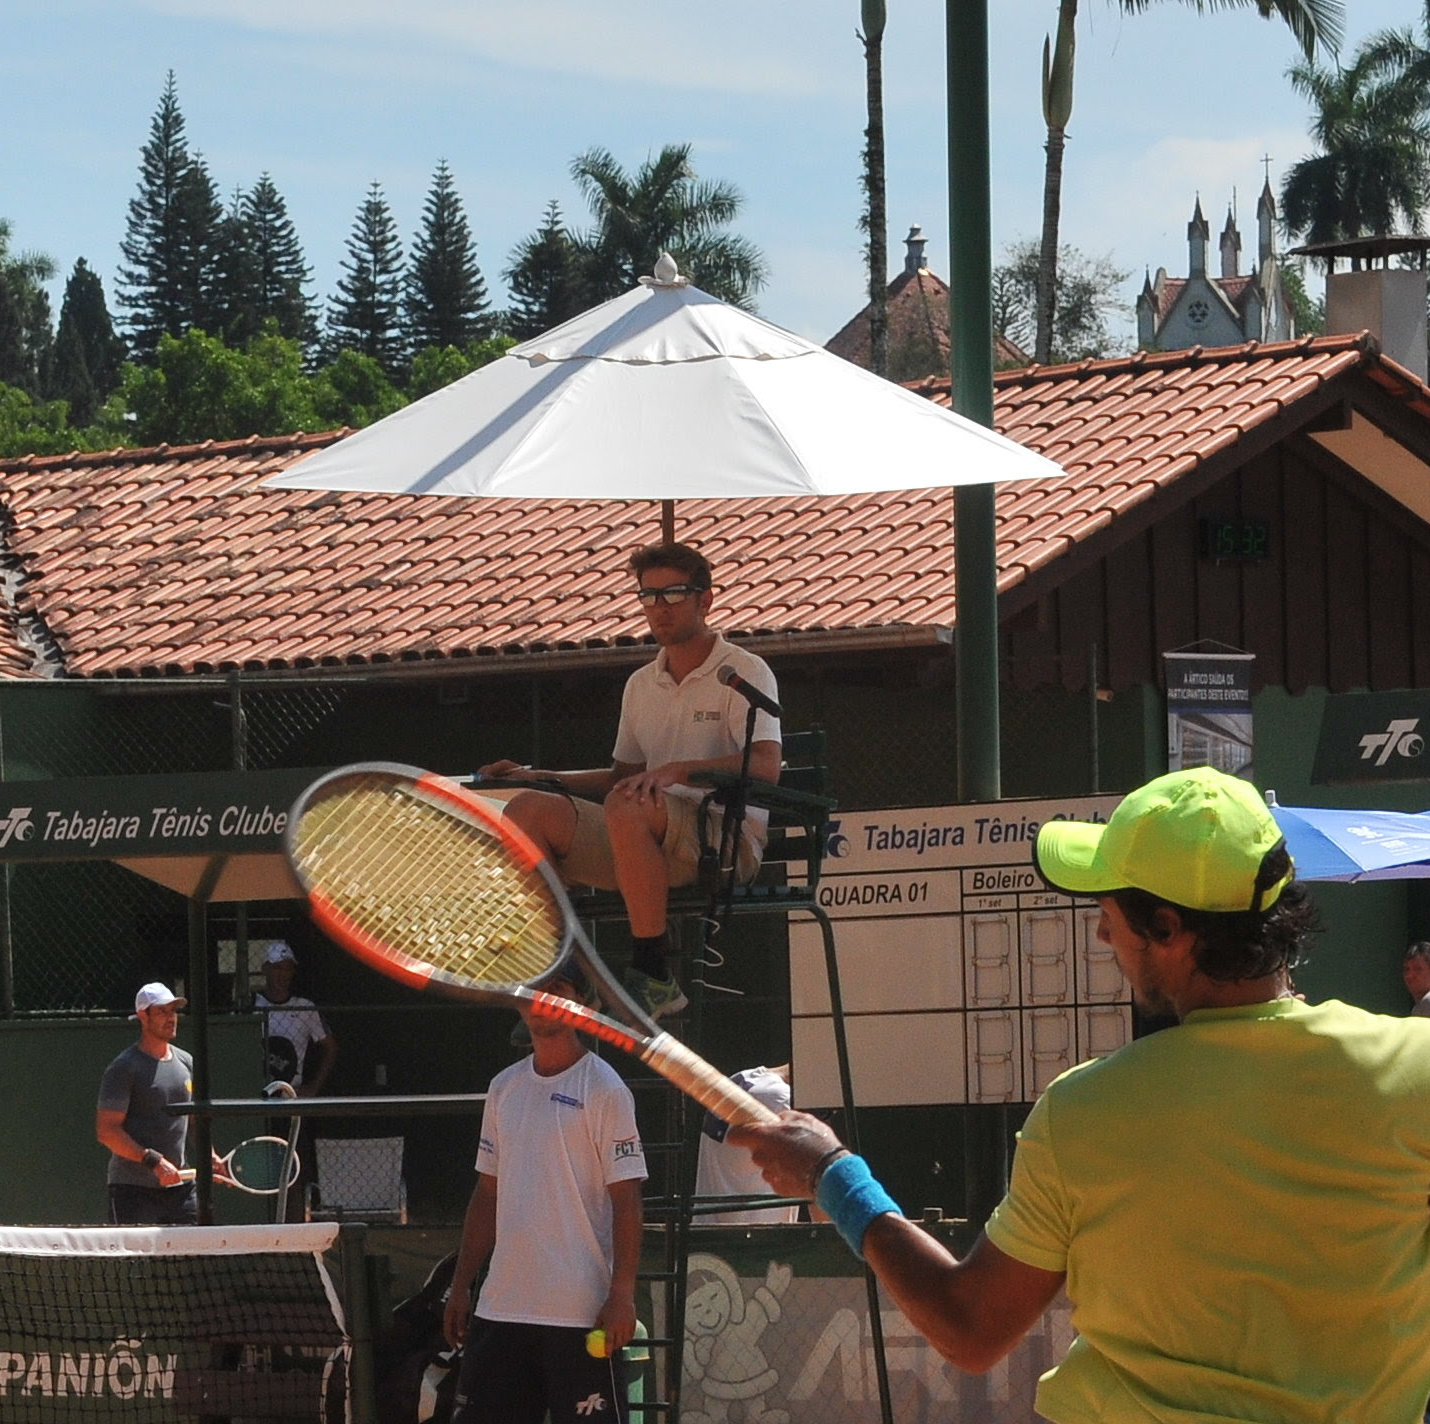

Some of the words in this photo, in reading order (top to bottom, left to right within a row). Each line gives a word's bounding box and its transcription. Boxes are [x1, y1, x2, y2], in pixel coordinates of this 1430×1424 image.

[43, 809, 141, 848] Tabajara
[149, 806, 212, 838] Tênis
[219, 805, 288, 837] Clube
[864, 822, 965, 855] Tabajara
[974, 816, 1040, 845] Tênis
[973, 869, 1035, 890] Boleiro
[819, 883, 903, 907] QUADRA
[908, 881, 928, 903] 01
[989, 898, 1002, 907] set
[1045, 895, 1059, 905] set
[614, 1141, 636, 1156] FCT
